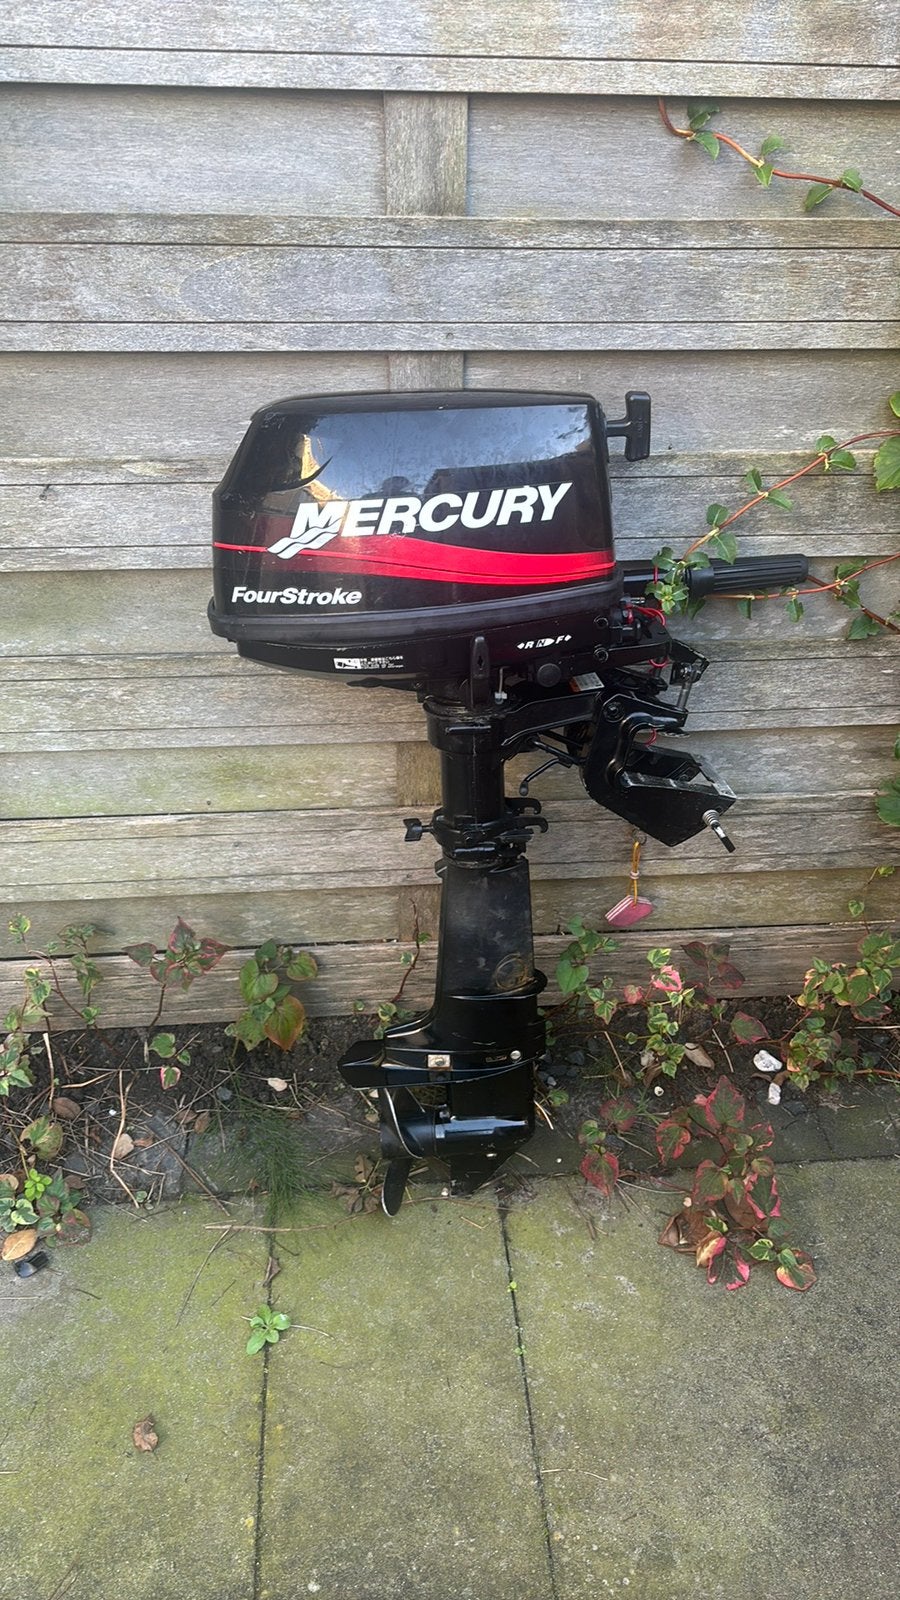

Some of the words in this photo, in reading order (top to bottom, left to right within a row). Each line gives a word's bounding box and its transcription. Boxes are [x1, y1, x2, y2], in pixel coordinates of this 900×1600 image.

[268, 482, 573, 558] MERCURY
[231, 586, 363, 605] FourStroke
[524, 641, 535, 650] R
[555, 635, 565, 644] F
